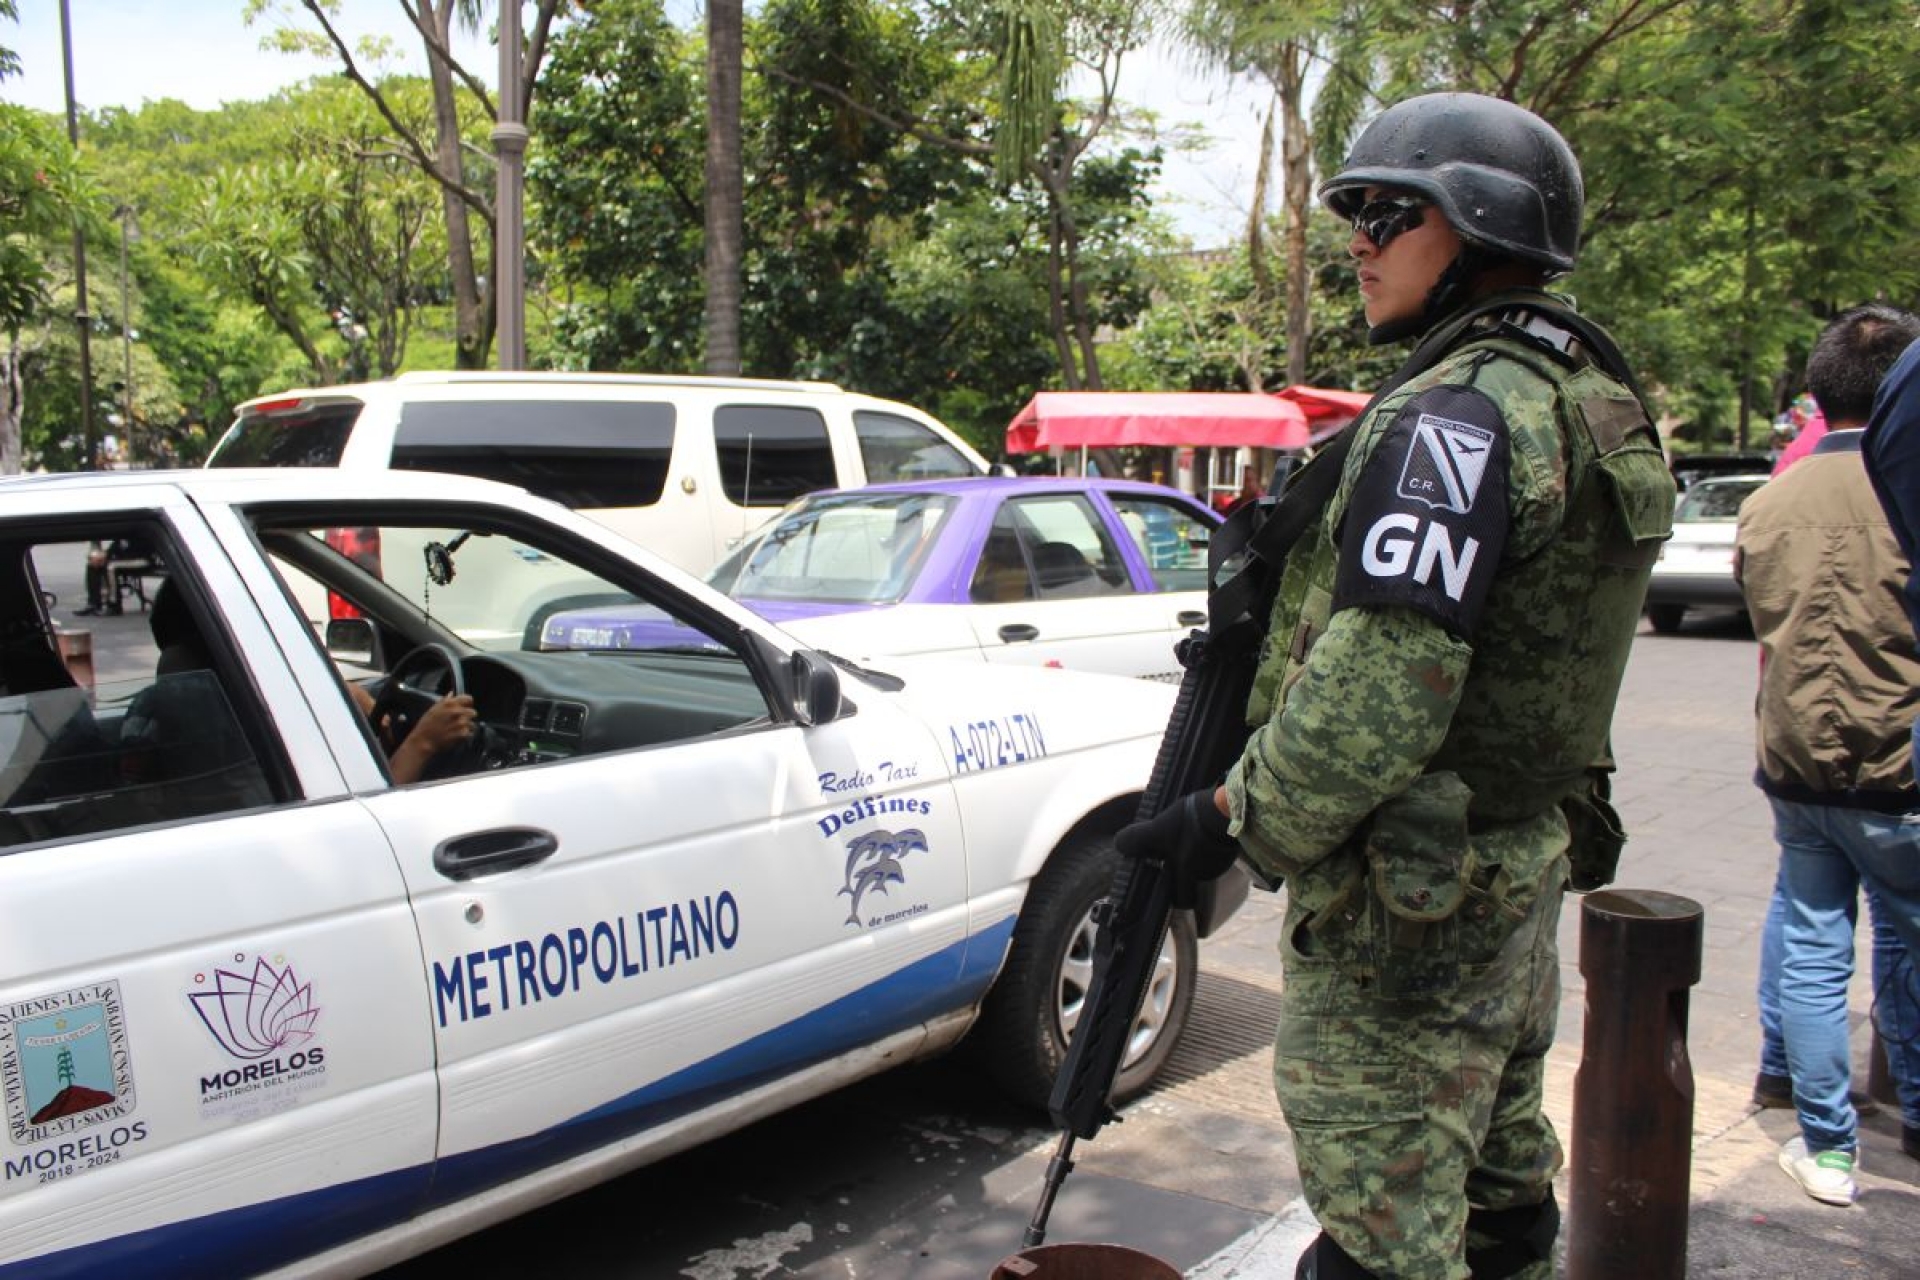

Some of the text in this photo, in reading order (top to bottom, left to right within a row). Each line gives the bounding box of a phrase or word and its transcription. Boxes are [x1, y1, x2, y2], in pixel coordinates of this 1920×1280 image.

[1408, 477, 1435, 492] C.R.
[1361, 512, 1480, 602] GN
[949, 711, 1047, 774] A-072-LTN
[818, 761, 918, 796] Radio Taxi
[816, 794, 932, 838] Delfines
[868, 902, 929, 928] de morelos
[433, 890, 739, 1028] METROPOLITANO
[201, 1047, 324, 1094] MORELOS
[263, 1076, 284, 1089] DEL
[287, 1065, 326, 1081] MUNDO
[5, 1121, 147, 1180] MORELOS
[39, 1164, 73, 1184] 2018
[87, 1151, 120, 1167] 2024
